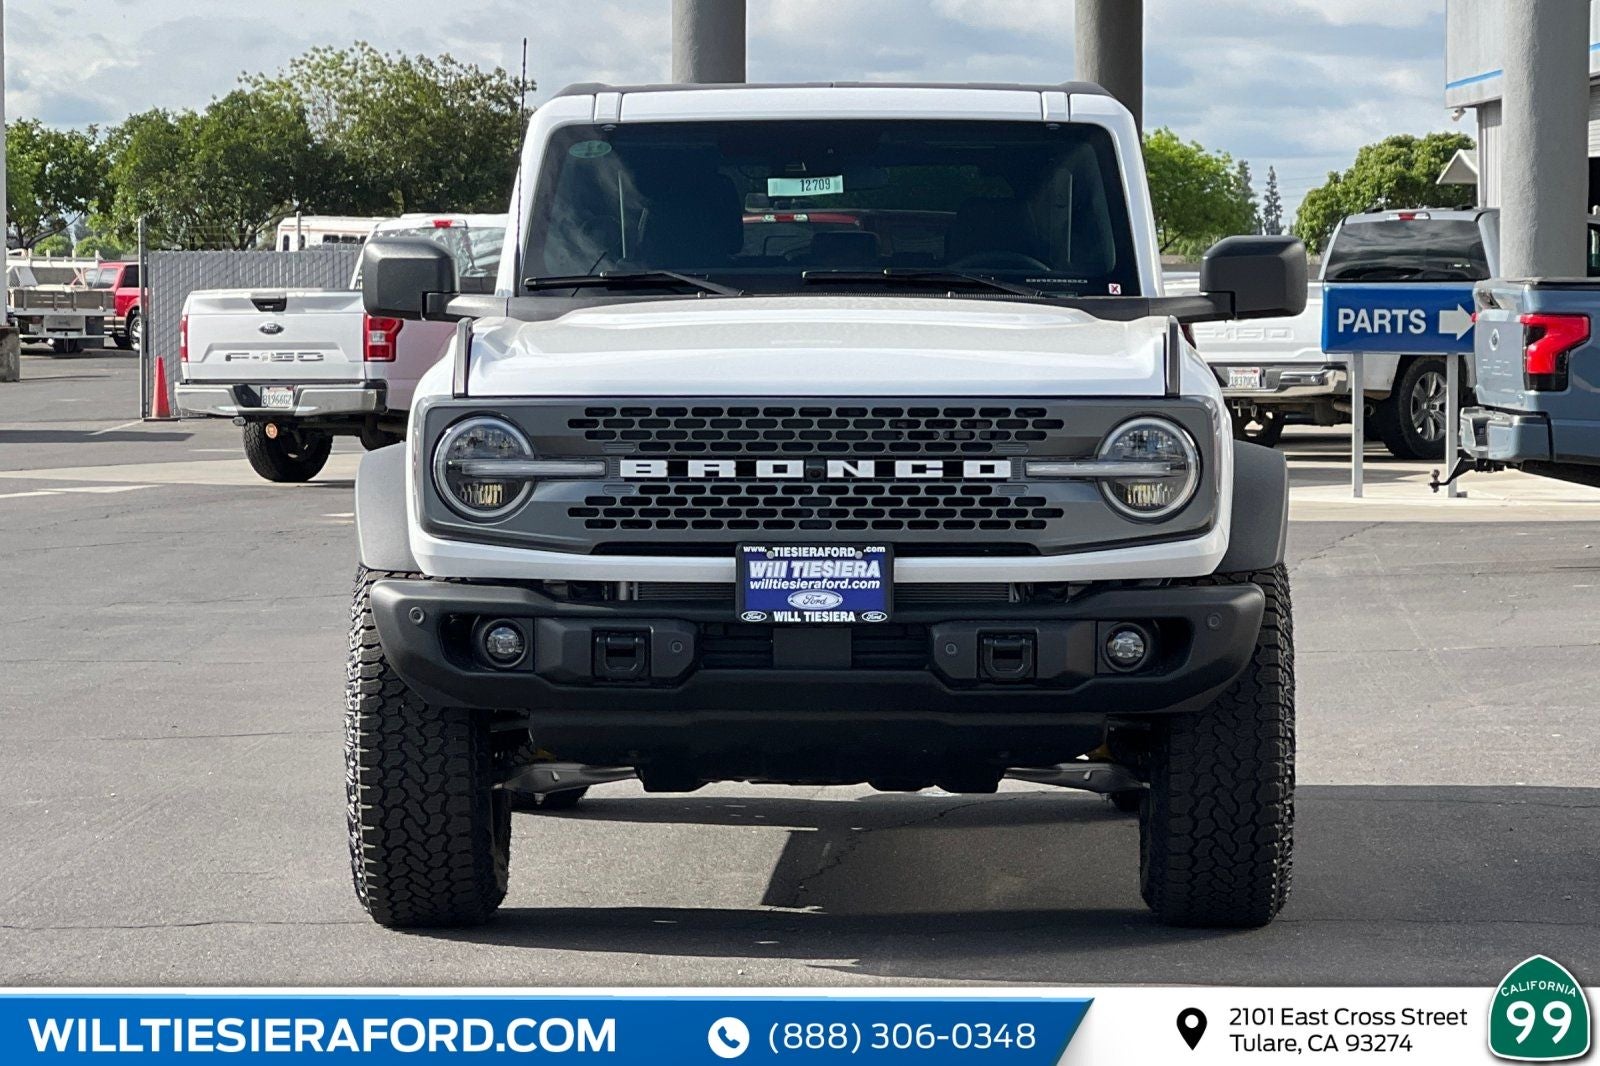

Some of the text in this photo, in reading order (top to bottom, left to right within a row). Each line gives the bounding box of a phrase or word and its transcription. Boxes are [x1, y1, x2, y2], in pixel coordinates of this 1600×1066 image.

[801, 178, 831, 192] 12709
[1338, 308, 1427, 334] PARTS
[620, 460, 1011, 478] BRONCO
[773, 547, 856, 558] TIESIERAFORD
[749, 560, 881, 578] Will TIESIERA
[750, 578, 880, 589] willtiesieraford.com
[802, 594, 828, 606] Ford
[773, 611, 856, 622] WILL TIESIERA
